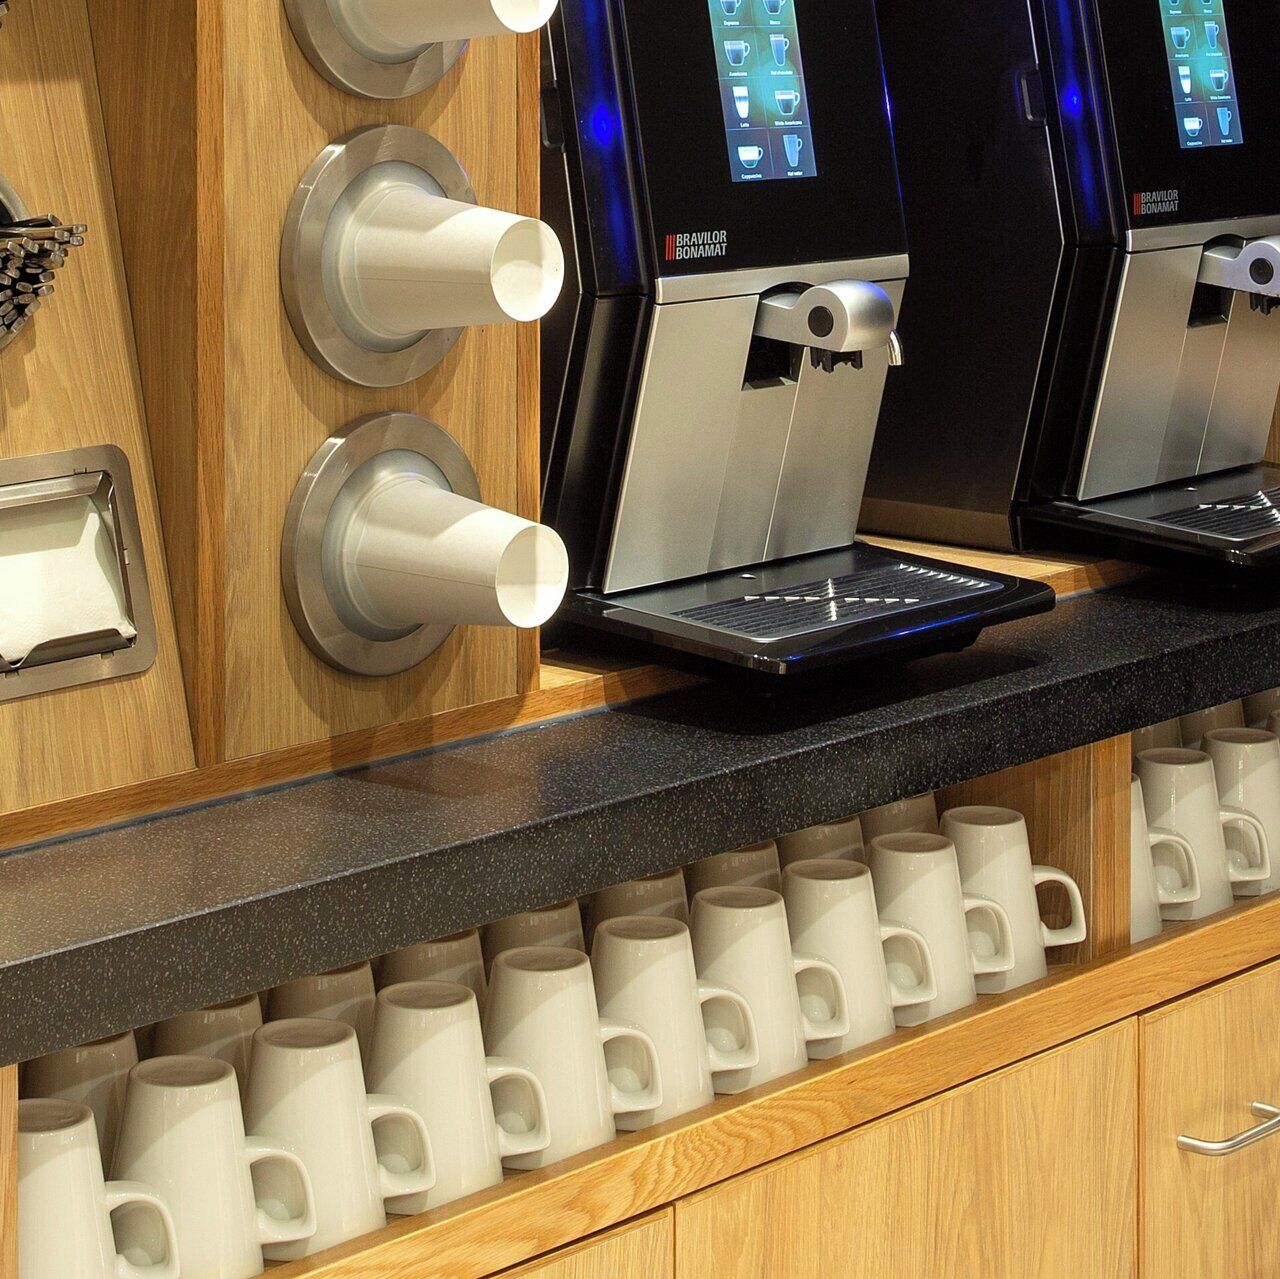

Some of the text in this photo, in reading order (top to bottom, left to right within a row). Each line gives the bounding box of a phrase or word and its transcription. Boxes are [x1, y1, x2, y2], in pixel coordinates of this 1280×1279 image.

[1141, 190, 1179, 203] BRAVILOR
[1141, 201, 1179, 214] BONAMAT
[676, 230, 727, 246] BRAVILOR
[676, 243, 728, 260] BONAMAT
